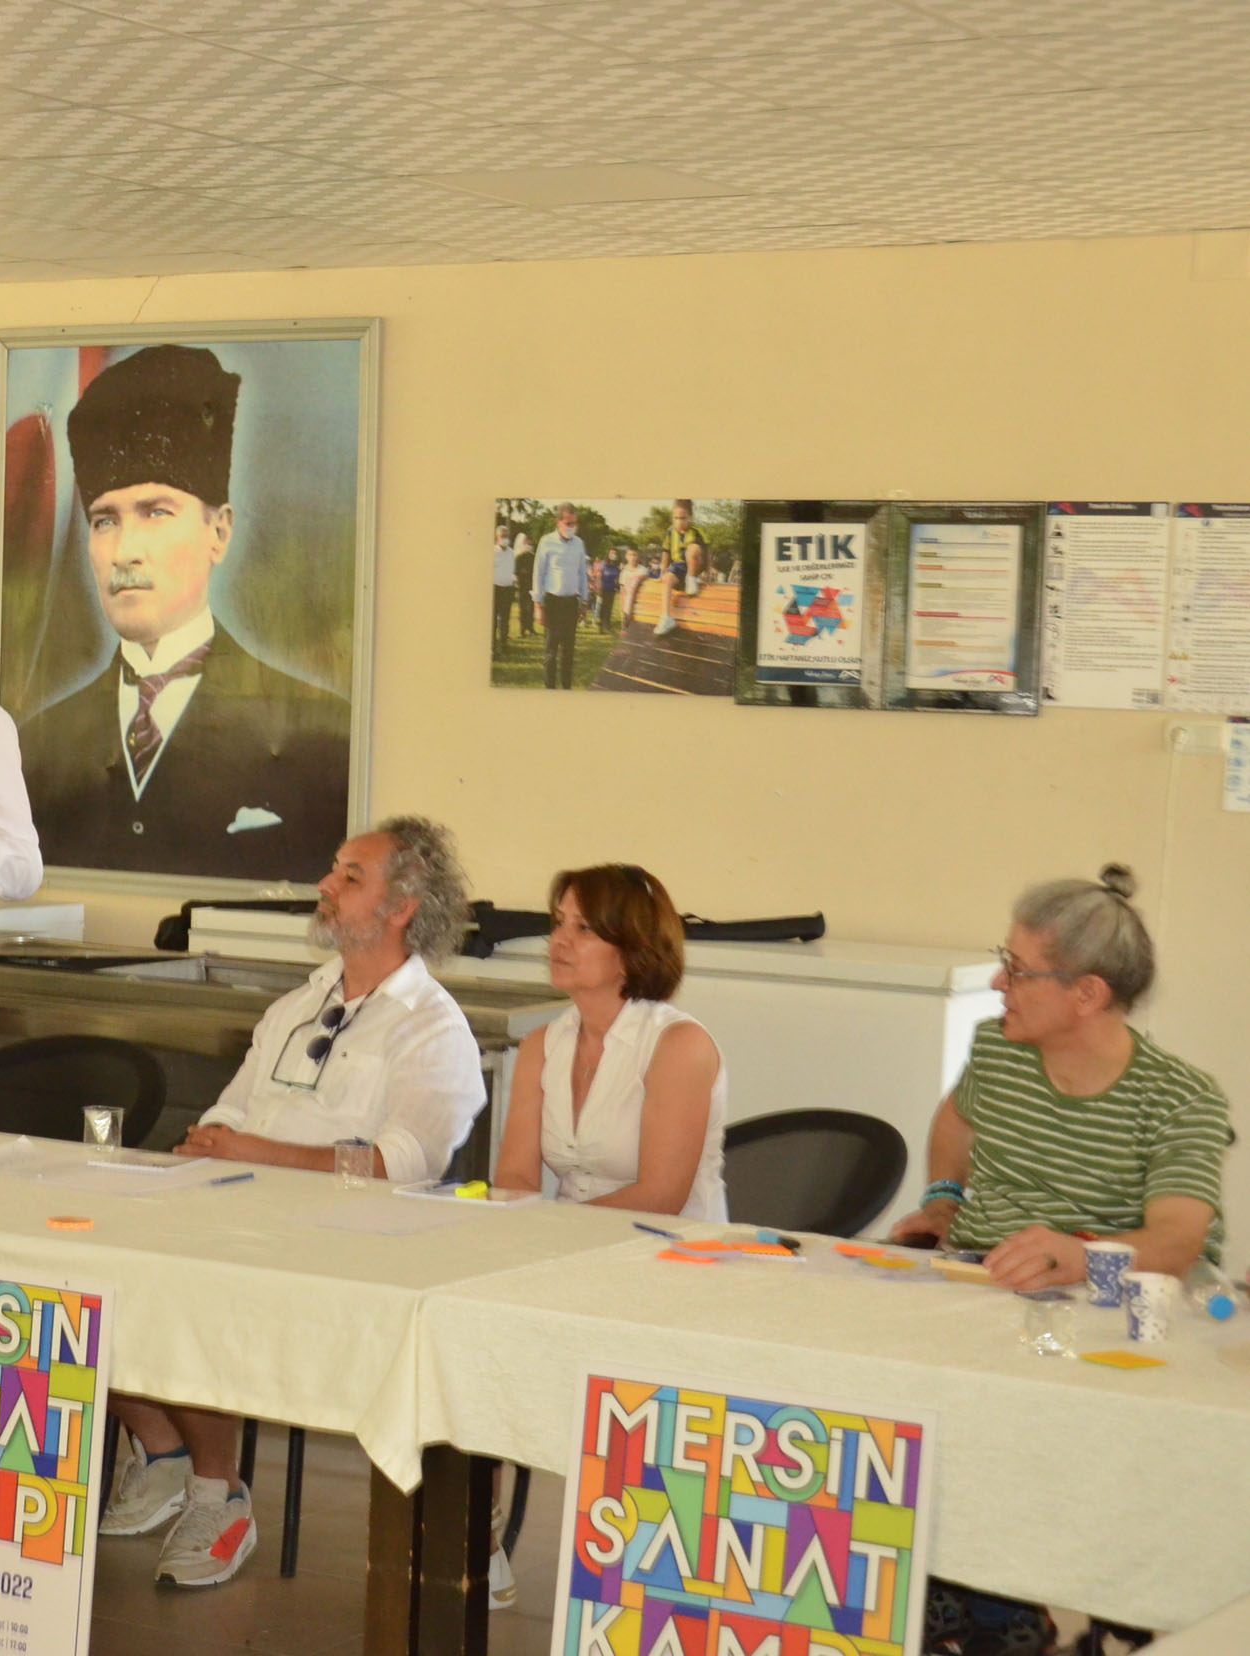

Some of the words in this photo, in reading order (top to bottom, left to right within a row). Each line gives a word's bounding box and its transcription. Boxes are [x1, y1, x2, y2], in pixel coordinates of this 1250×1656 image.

[775, 533, 856, 561] ETİK
[596, 1392, 907, 1506] MERSİN
[585, 1496, 898, 1611] SANAT
